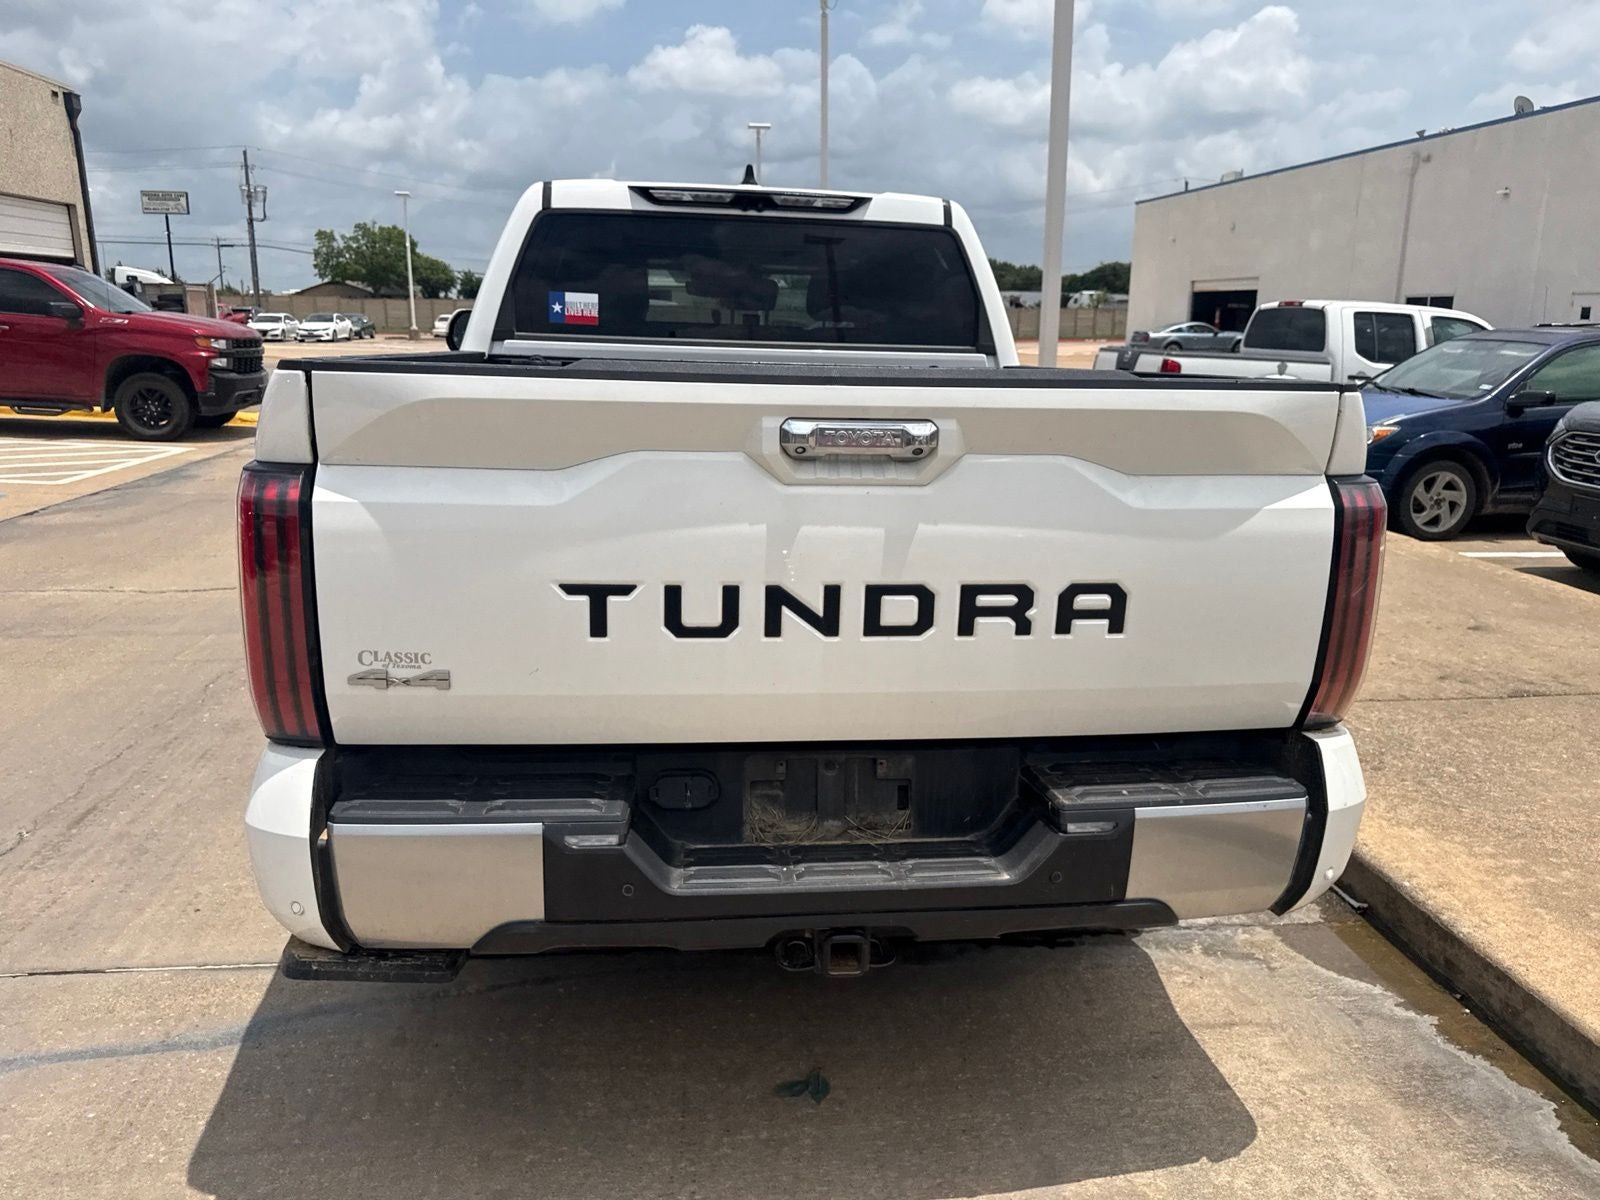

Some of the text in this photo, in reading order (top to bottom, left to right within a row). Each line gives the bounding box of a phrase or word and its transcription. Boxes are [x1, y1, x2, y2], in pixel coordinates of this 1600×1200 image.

[824, 430, 896, 446] TOYOTA
[557, 582, 1128, 638] TUNDRA
[357, 649, 432, 666] CLASSIC
